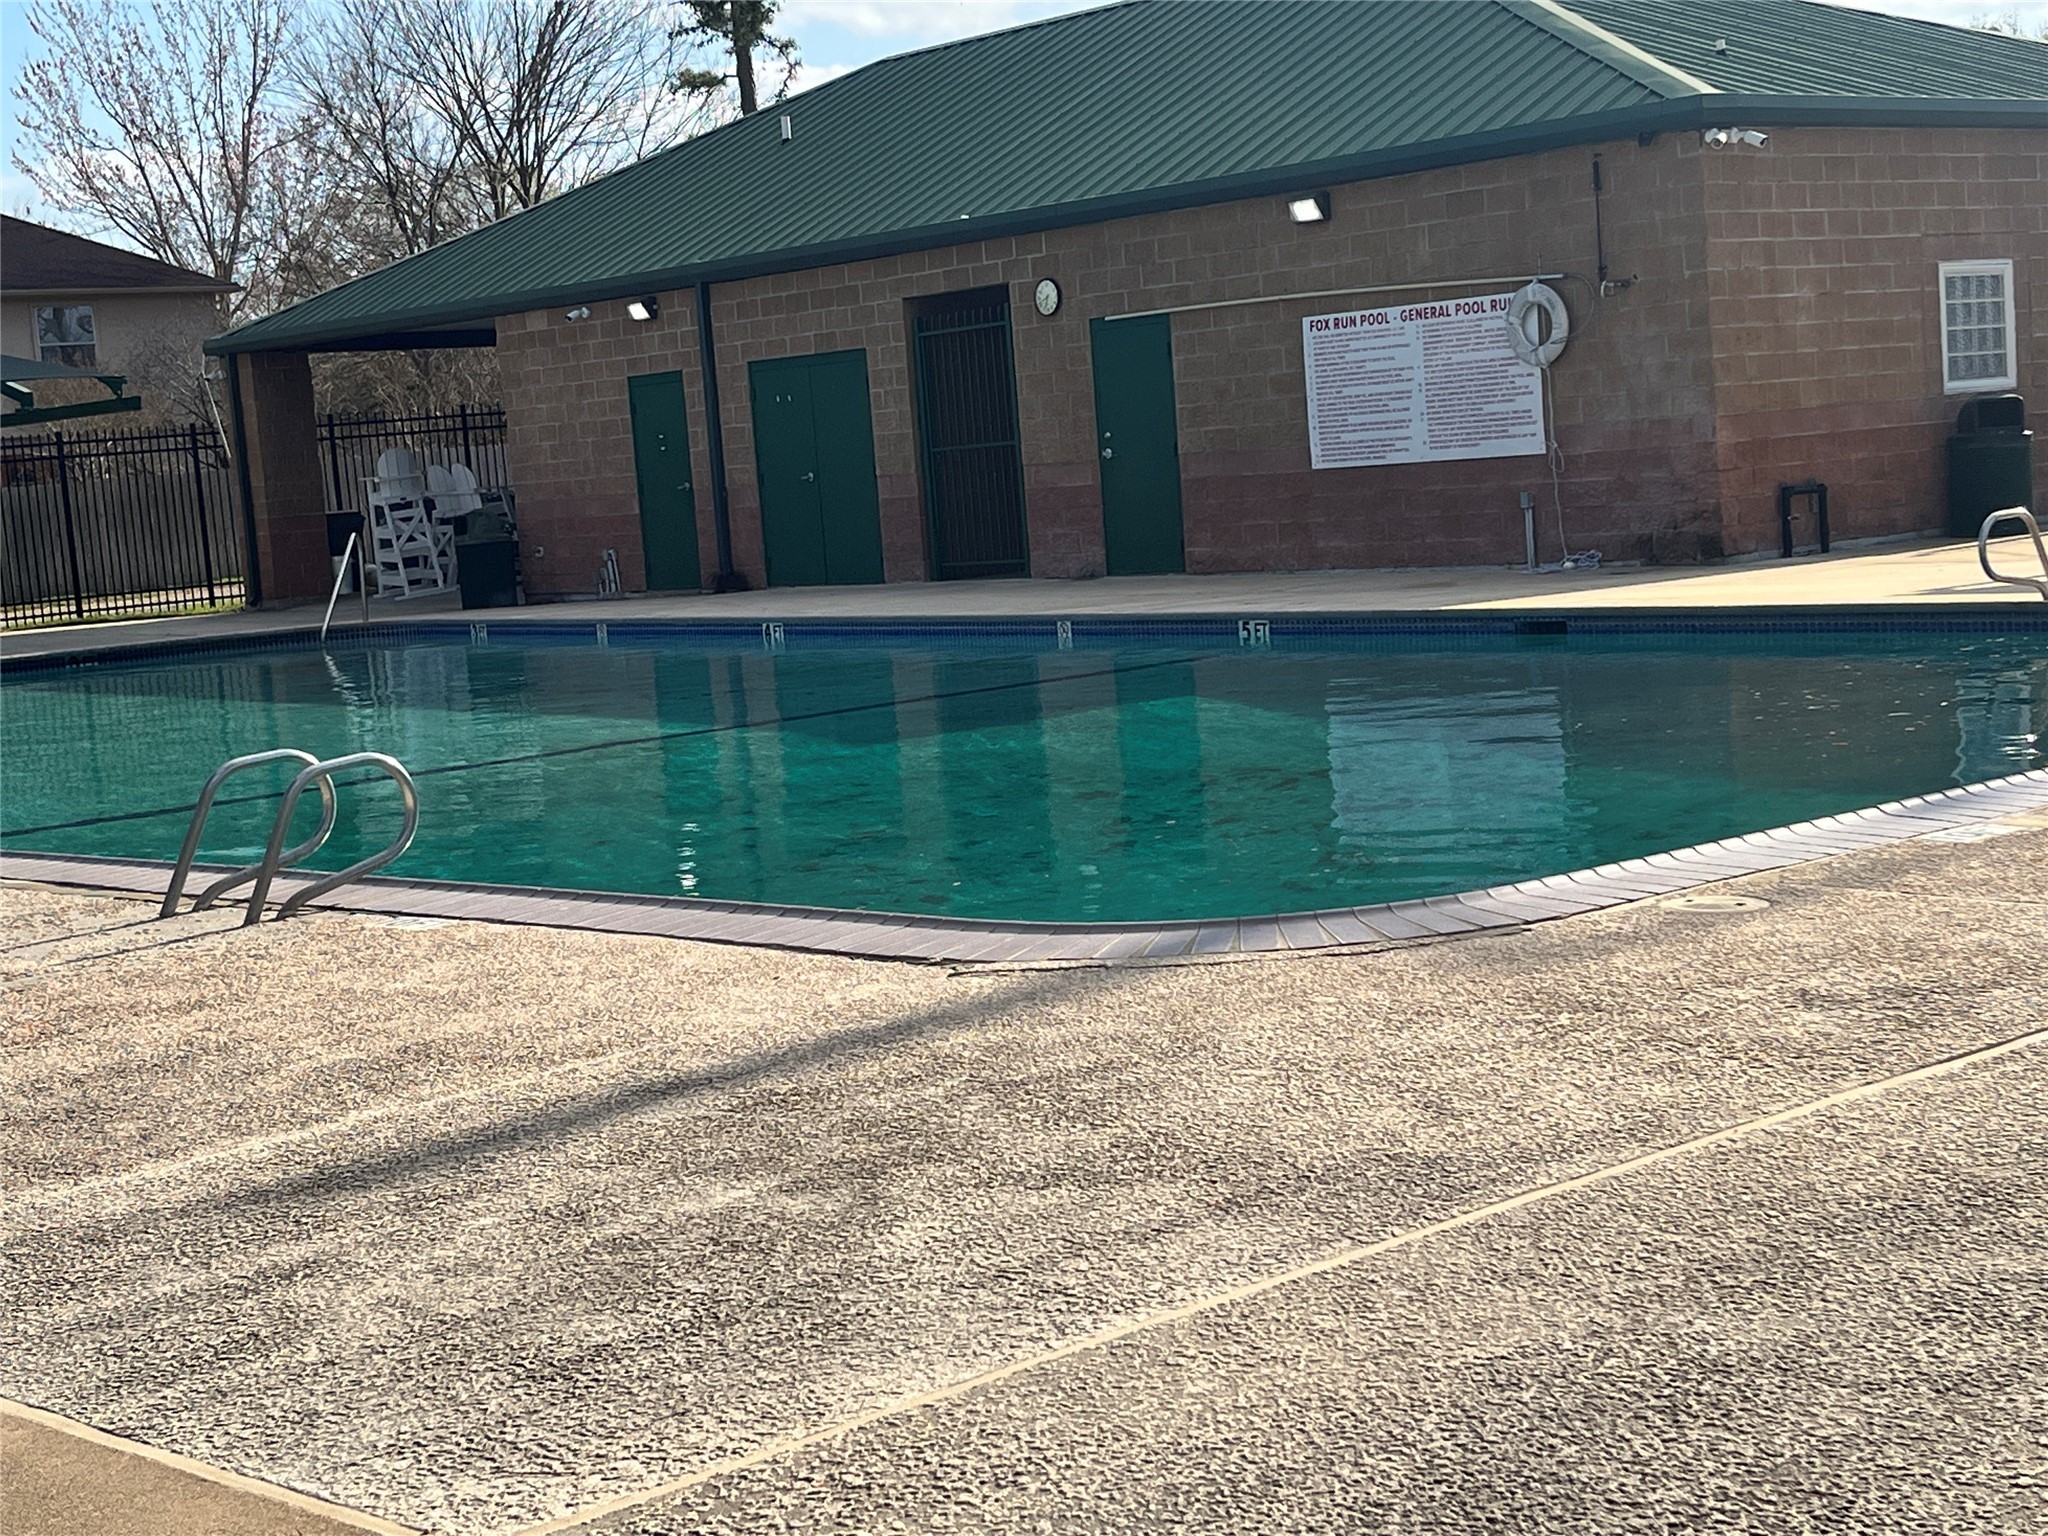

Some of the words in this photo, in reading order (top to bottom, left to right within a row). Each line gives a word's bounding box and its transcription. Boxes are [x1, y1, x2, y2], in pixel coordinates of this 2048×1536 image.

[1309, 318, 1331, 333] FOX
[1333, 315, 1357, 330] RUN
[1360, 312, 1390, 327] POOL
[1400, 304, 1452, 322] GENERAL
[1455, 300, 1487, 316] POOL
